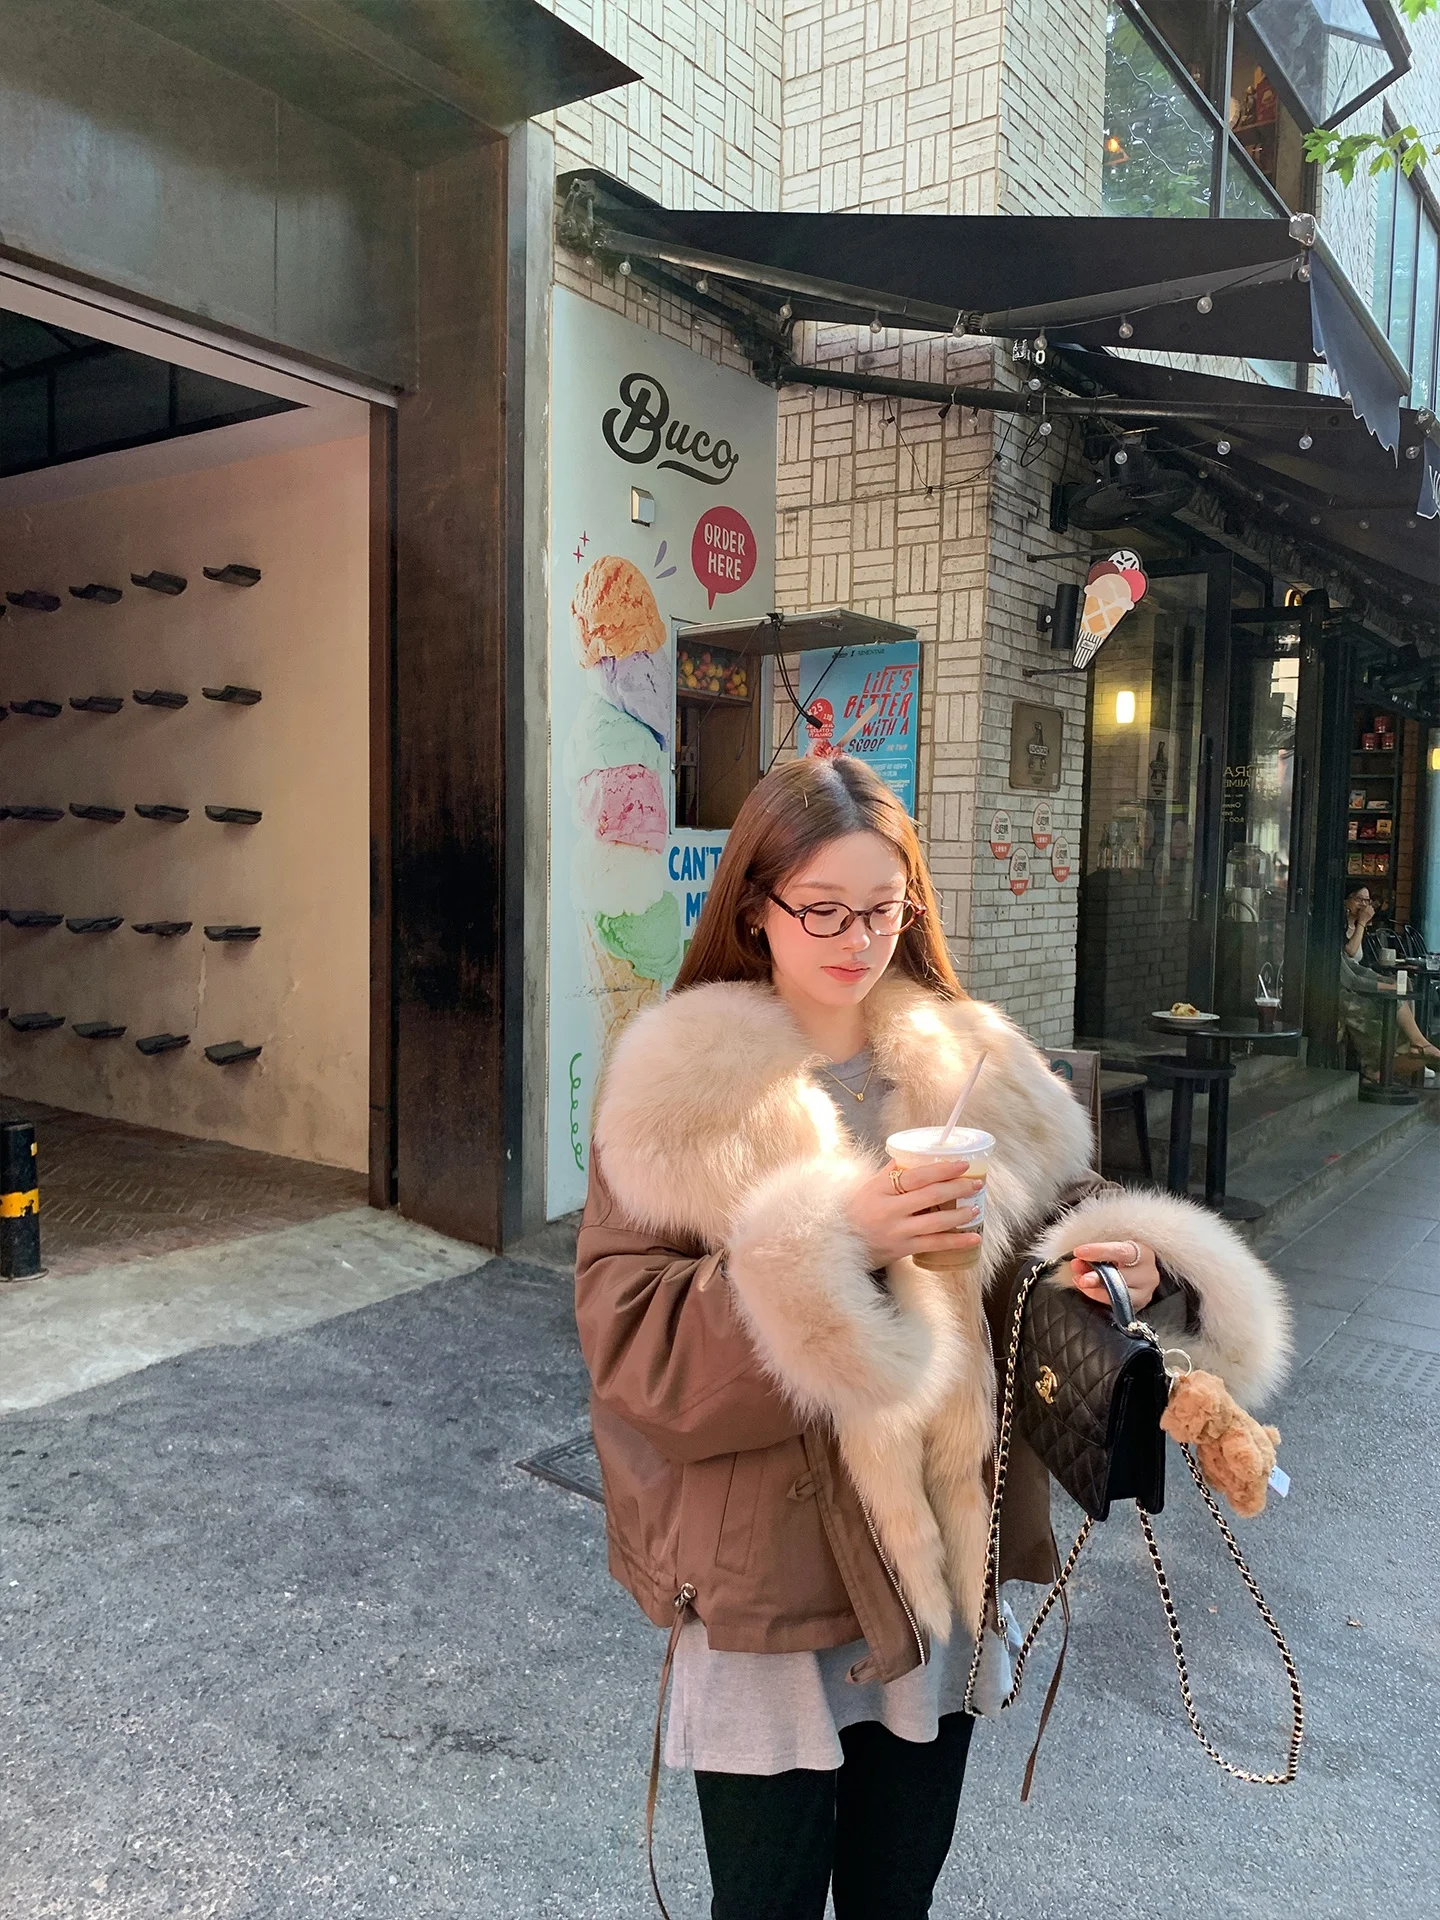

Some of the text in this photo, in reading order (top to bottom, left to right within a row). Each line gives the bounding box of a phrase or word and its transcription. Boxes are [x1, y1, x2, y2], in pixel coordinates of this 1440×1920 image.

[602, 372, 739, 486] Buco
[704, 523, 745, 556] ORDER
[707, 550, 743, 582] HERE
[843, 692, 913, 719] BETTER
[900, 717, 910, 736] A
[848, 737, 885, 753] SCOOP
[668, 845, 723, 881] CAN'T
